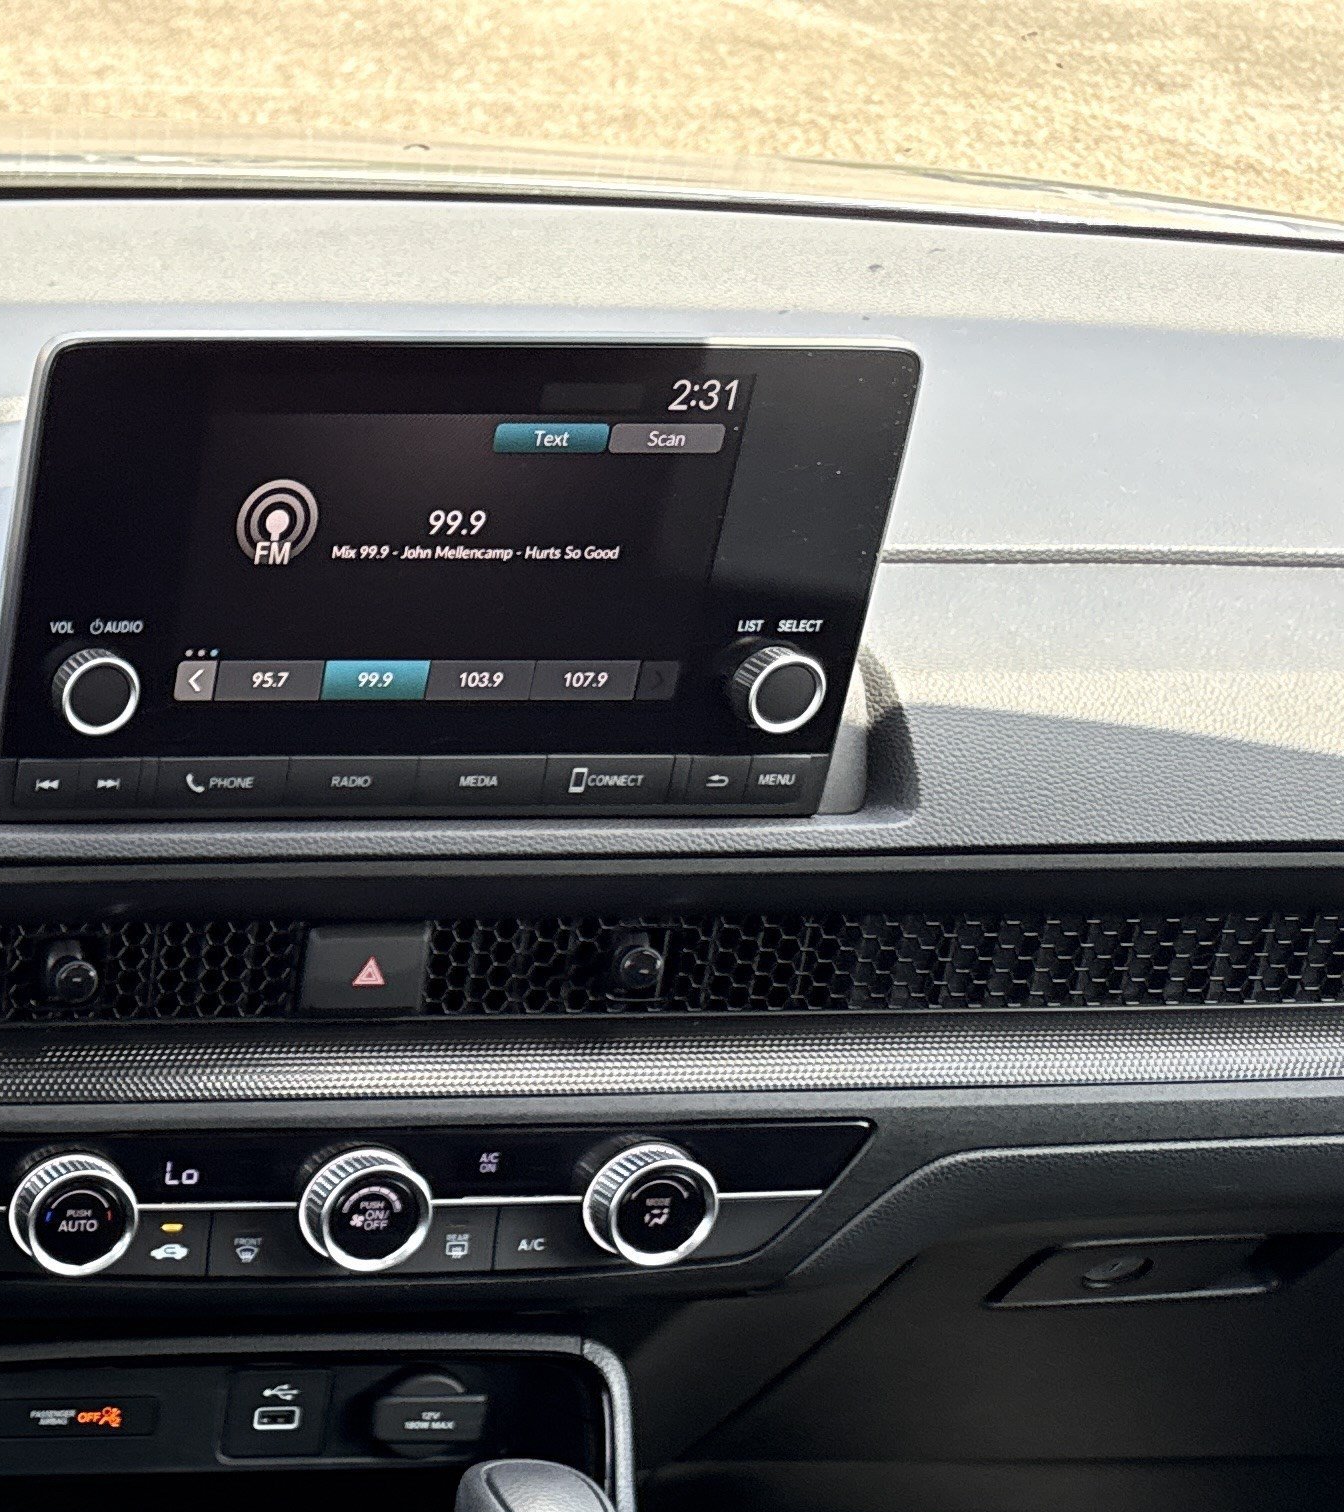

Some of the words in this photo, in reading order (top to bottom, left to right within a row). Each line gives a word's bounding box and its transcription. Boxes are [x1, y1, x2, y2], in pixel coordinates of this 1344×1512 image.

[667, 379, 739, 411] 2:31
[534, 430, 569, 447] Text
[647, 430, 686, 447] Scan
[428, 509, 487, 536] 99.9
[253, 541, 291, 566] FM
[331, 545, 357, 560] Mix
[359, 545, 390, 560] 99.9
[400, 545, 432, 560] John
[434, 545, 513, 562] Mellencamp
[524, 546, 562, 560] Hurts
[564, 546, 582, 560] So
[583, 546, 620, 560] Good
[50, 621, 74, 634] VOL
[104, 620, 144, 634] AUDIO
[737, 619, 764, 632] LIST
[777, 619, 823, 632] SELECT
[251, 672, 290, 688] 95.7
[357, 672, 395, 688] 99.9
[458, 672, 504, 688] 103.9
[563, 672, 609, 688] 107.9
[208, 776, 254, 790] PHONE
[331, 775, 372, 788] RADIO
[459, 774, 498, 788] MEDIA
[587, 774, 645, 788] CONNECT
[758, 773, 796, 787] MENU
[479, 1152, 500, 1163] A/C
[165, 1161, 200, 1185] Lo
[479, 1163, 497, 1173] ON
[360, 1201, 385, 1210] PUSH
[66, 1209, 92, 1217] PUSH
[57, 1219, 98, 1232] AUTO
[363, 1220, 388, 1230] OFF
[233, 1237, 263, 1246] FRONT
[517, 1238, 546, 1251] A/C
[77, 1411, 102, 1423] OFF
